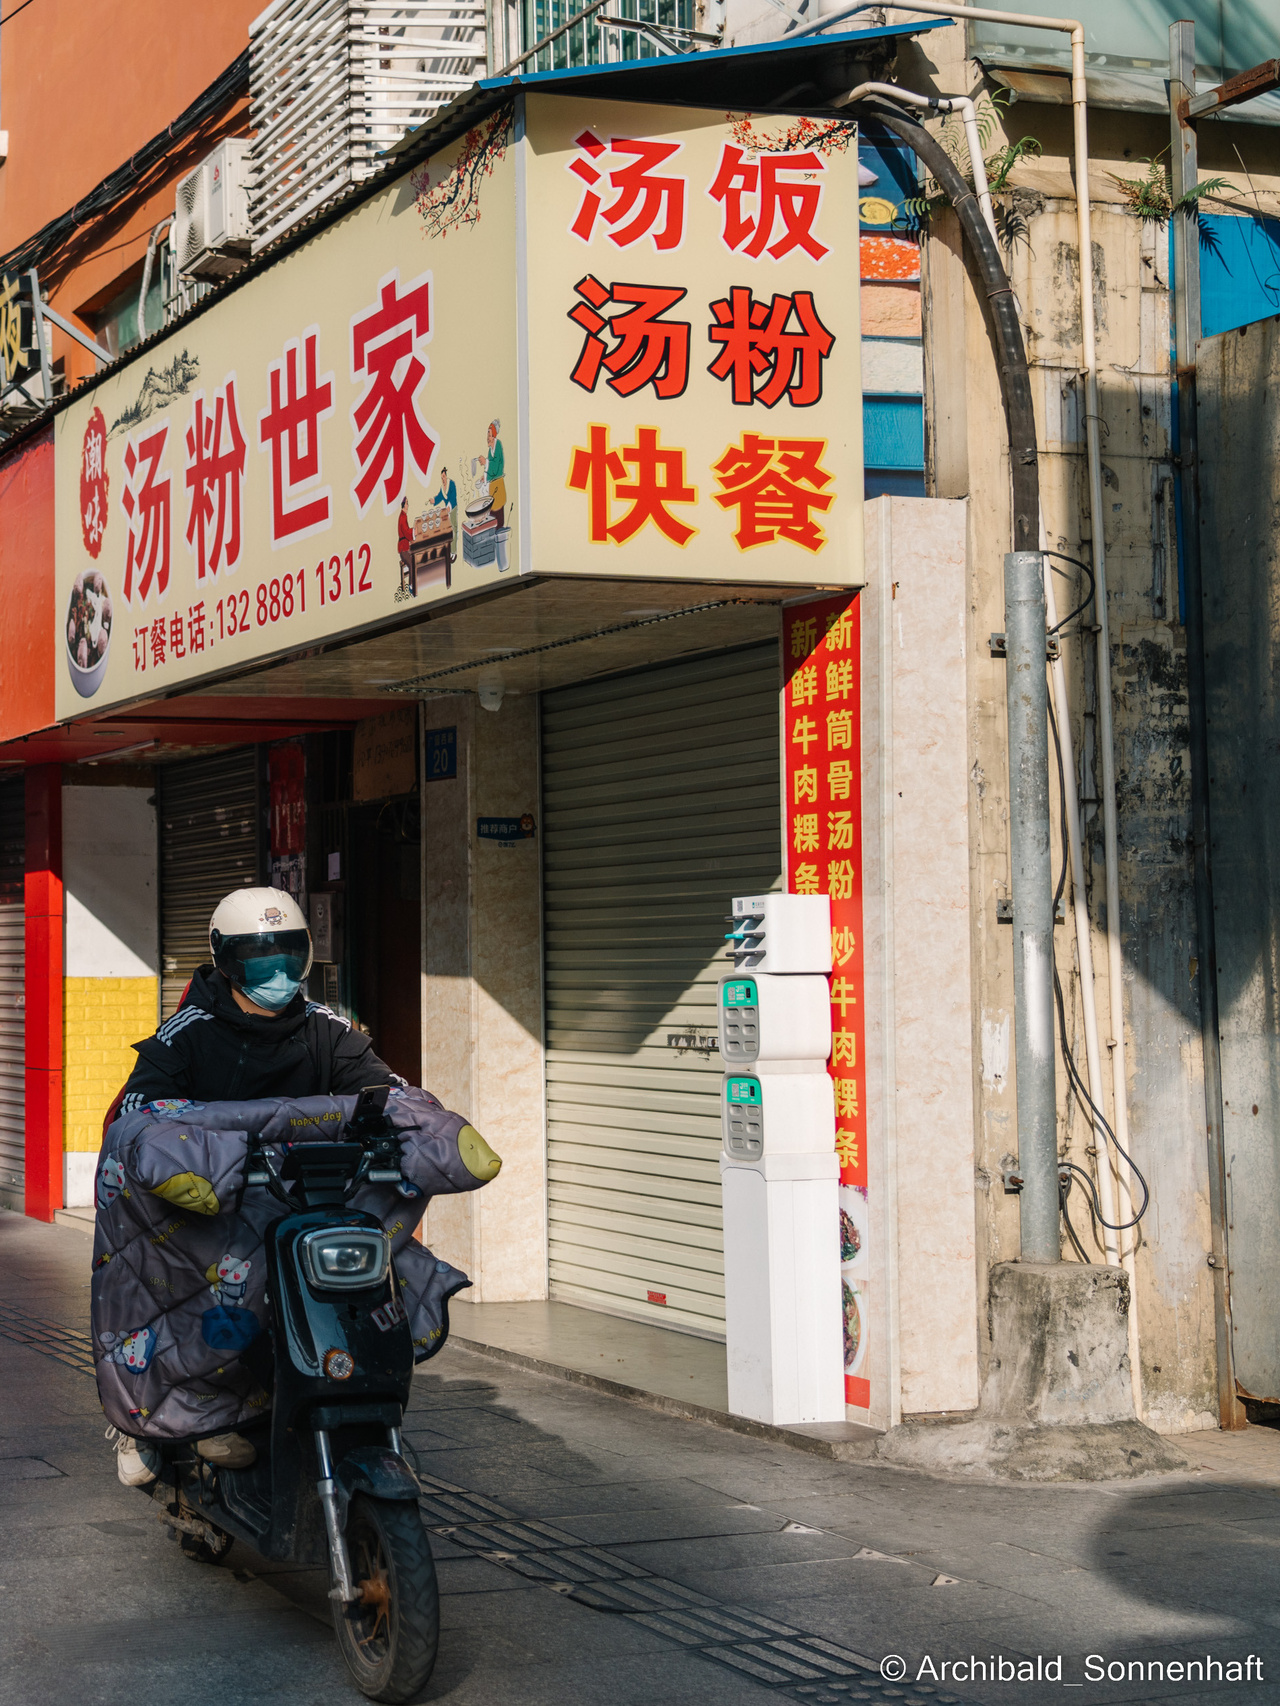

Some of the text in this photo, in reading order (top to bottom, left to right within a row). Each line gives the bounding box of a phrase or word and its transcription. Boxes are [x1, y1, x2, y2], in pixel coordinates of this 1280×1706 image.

[568, 129, 830, 264] 汤饭
[568, 274, 836, 407] 汤粉
[84, 432, 104, 546] 潮味
[120, 266, 438, 610] 汤粉世家
[567, 424, 835, 553] 快餐
[132, 542, 373, 674] 订餐电话:132 8881 1312
[433, 748, 448, 774] 20
[790, 617, 820, 896] 新鲜牛肉粿条
[825, 609, 855, 900] 新鲜筒骨汤粉
[480, 823, 517, 834] 推荐商户
[322, 1112, 342, 1121] day
[387, 1220, 404, 1239] day
